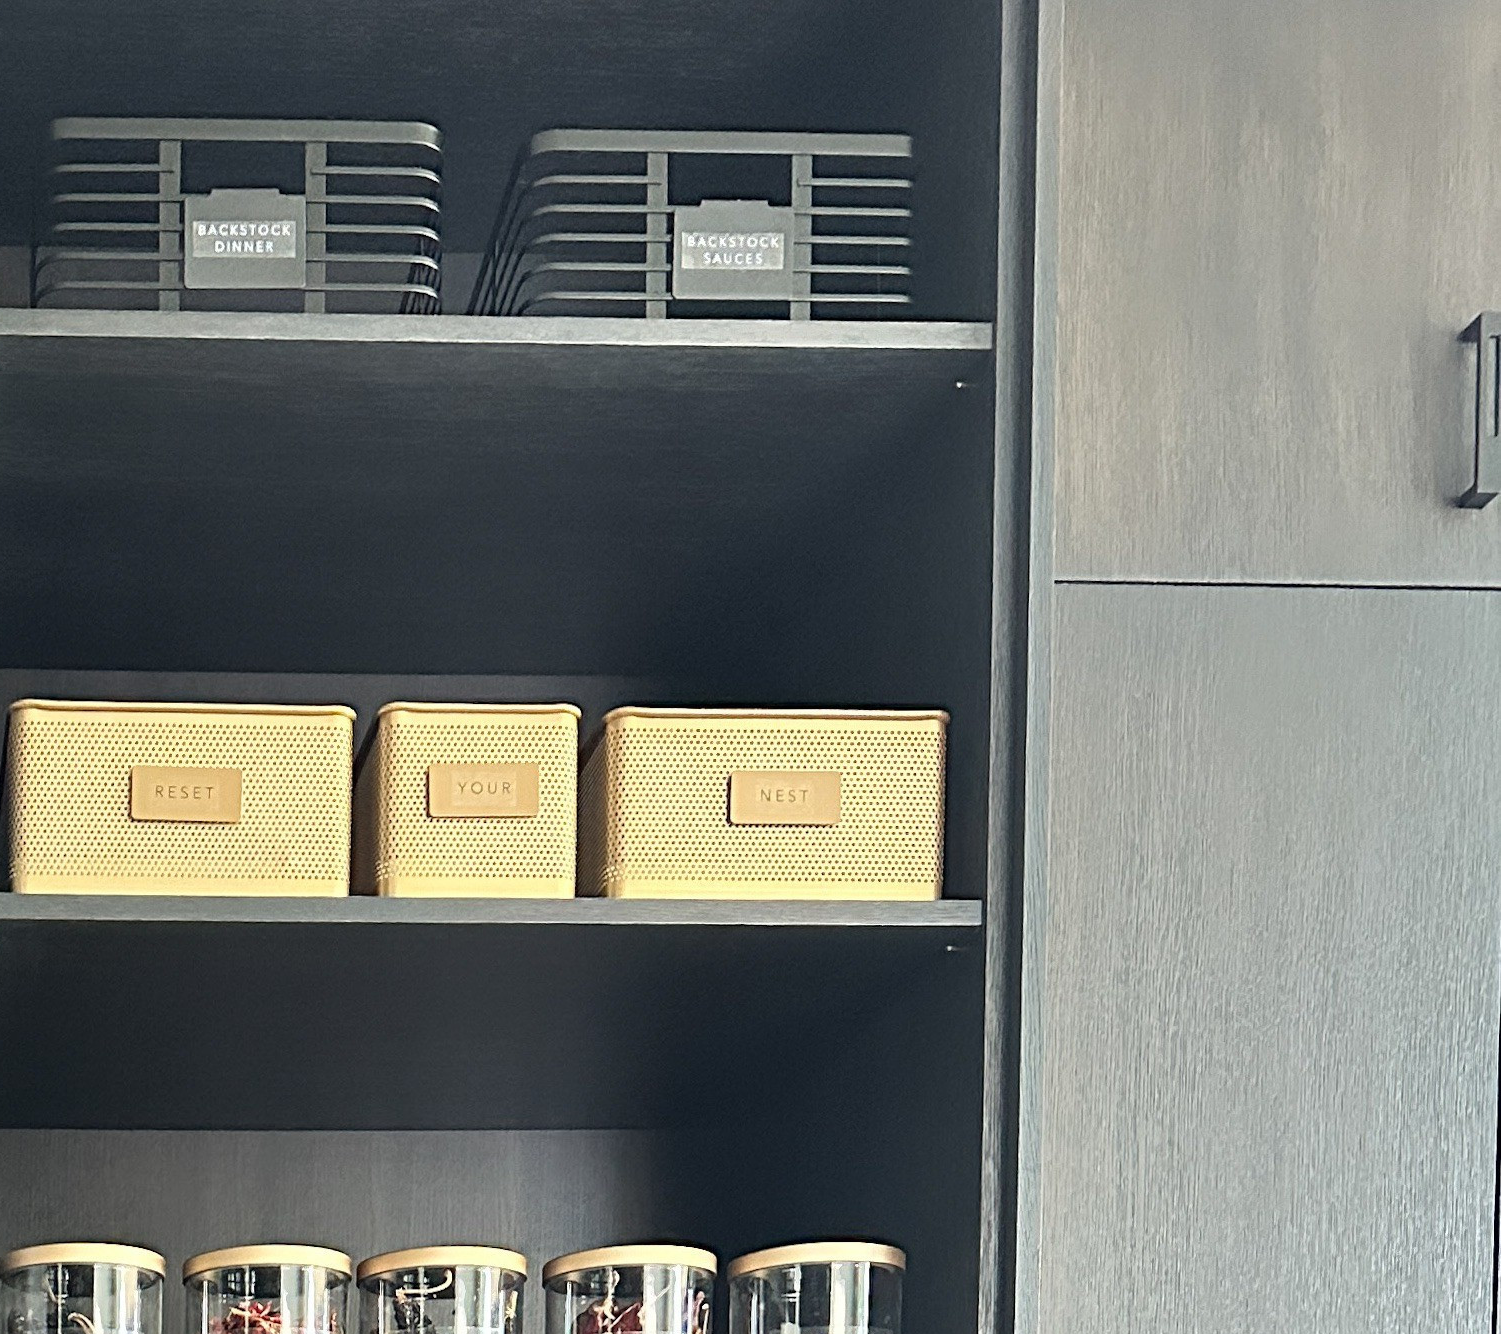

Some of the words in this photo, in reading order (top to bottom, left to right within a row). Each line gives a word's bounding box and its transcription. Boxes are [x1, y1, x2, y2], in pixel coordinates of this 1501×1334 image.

[197, 223, 292, 237] BACKSTOCK
[213, 240, 275, 253] DINNER
[686, 233, 780, 248] BACKSTOCK
[702, 251, 763, 265] SAUCES
[154, 784, 216, 800] RESET
[457, 779, 513, 796] YOUR
[760, 787, 810, 804] NEST
